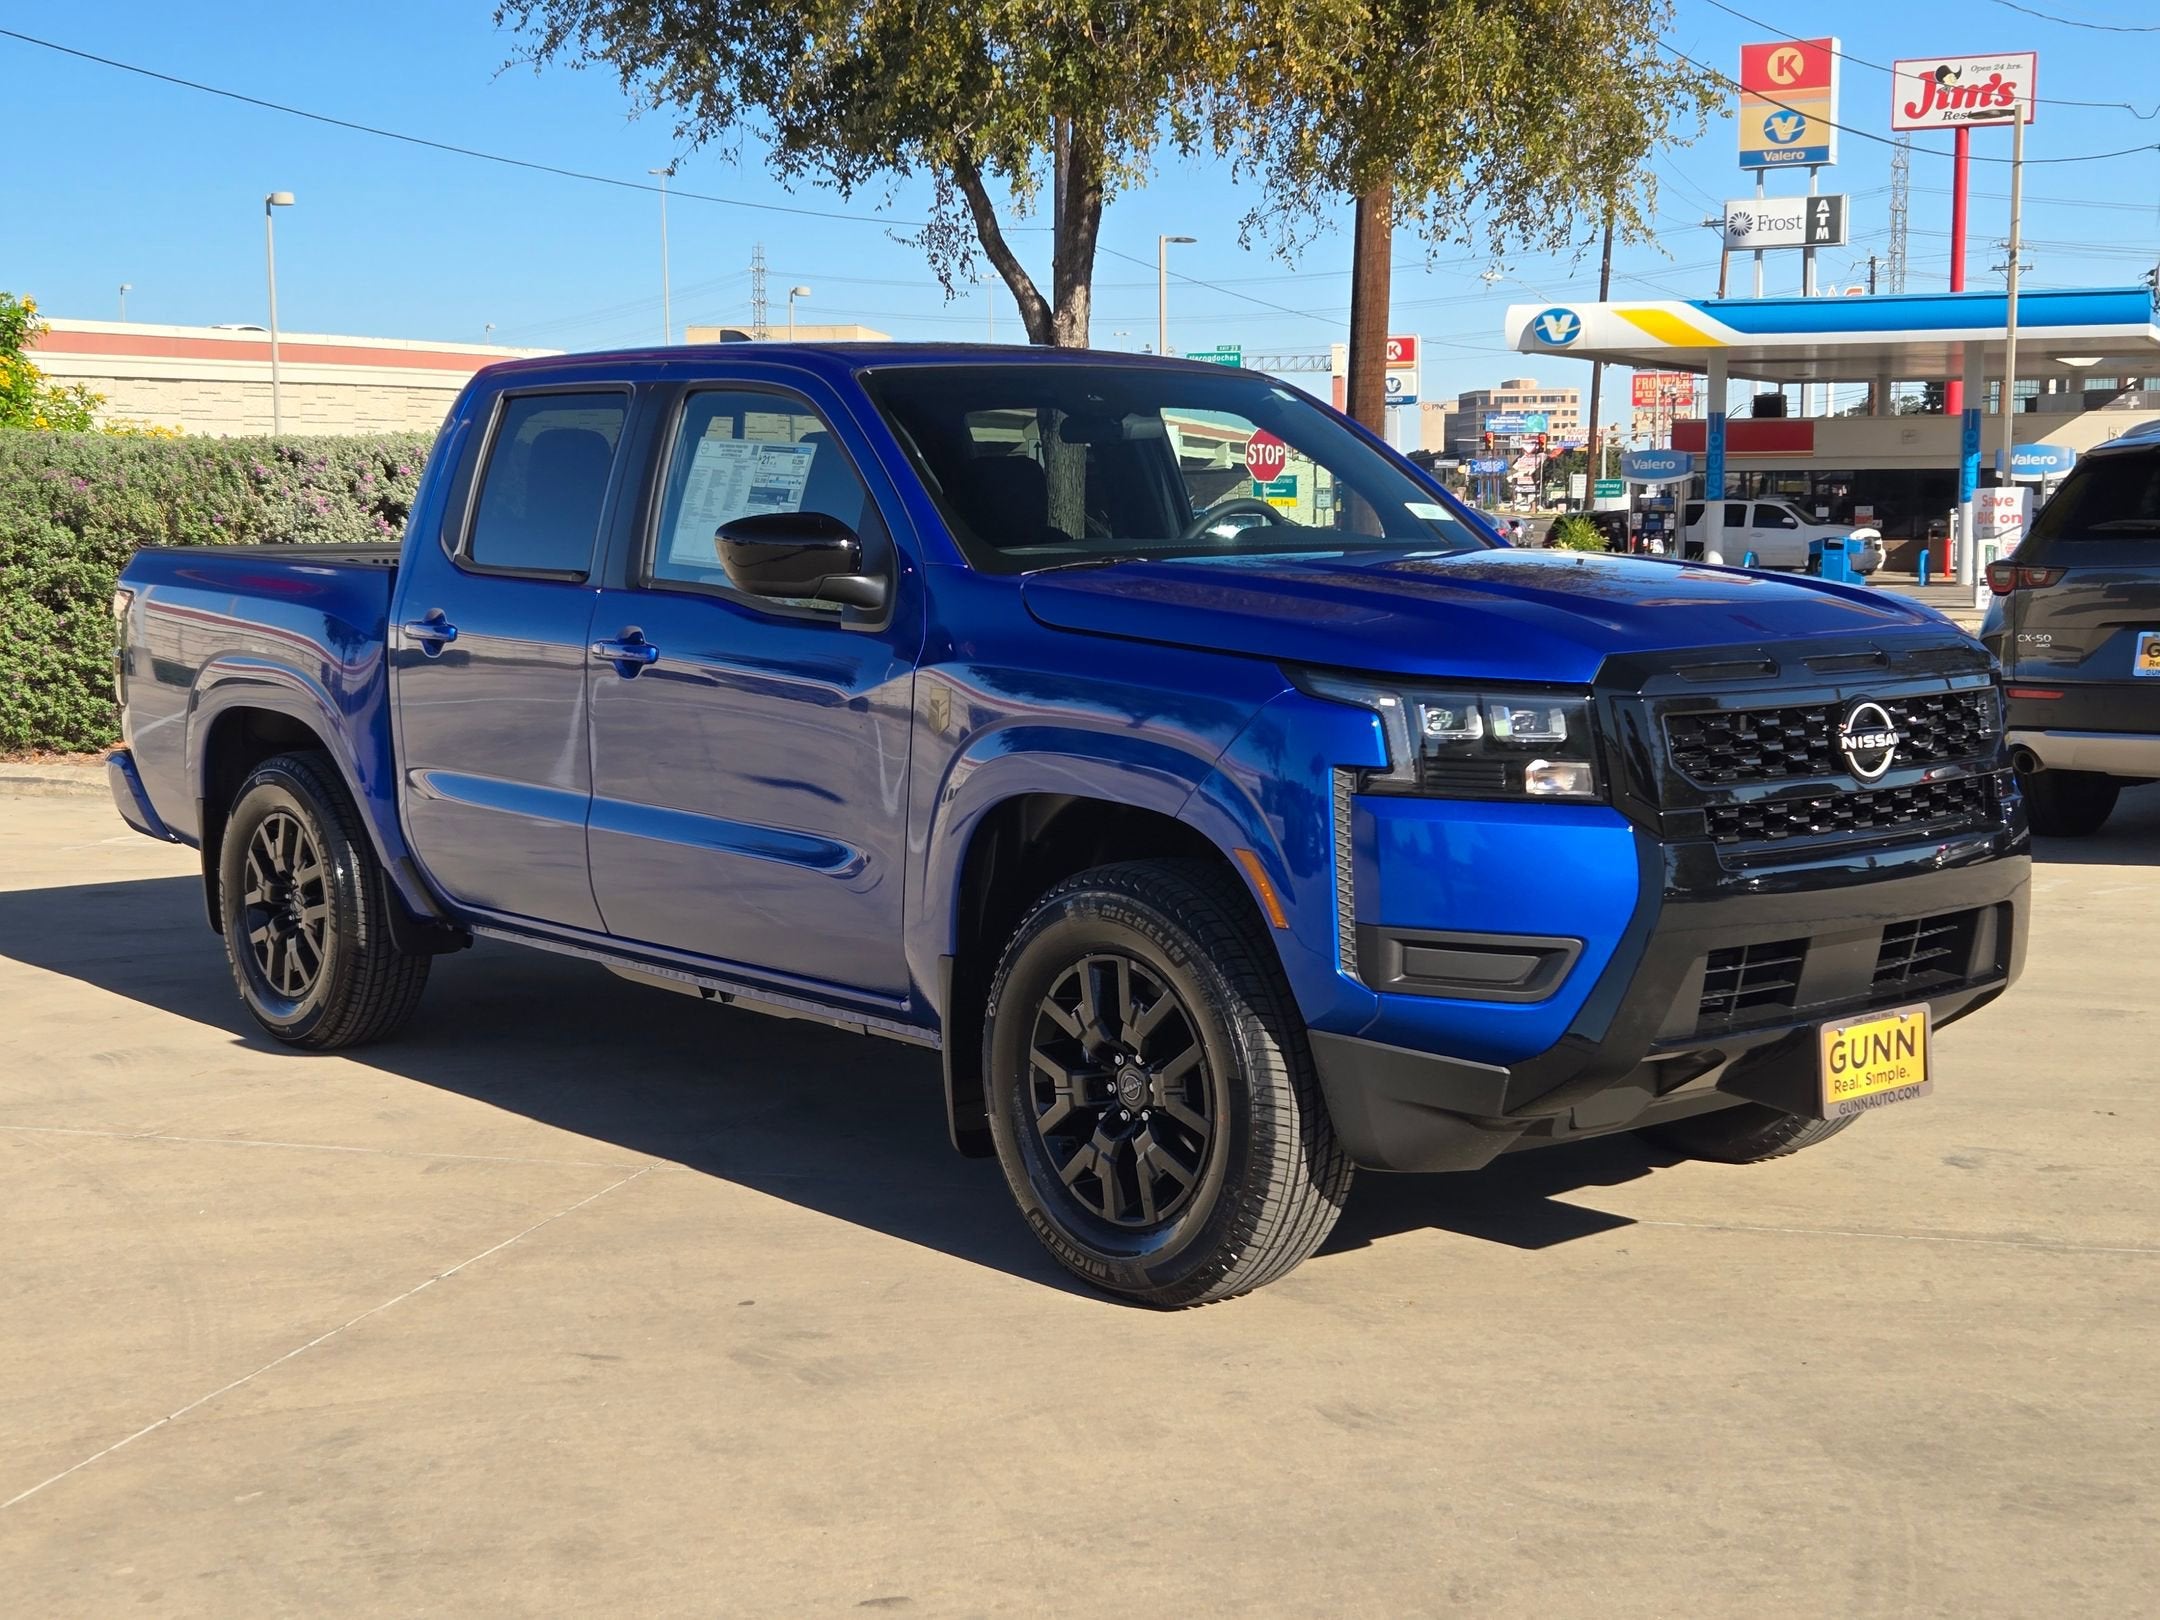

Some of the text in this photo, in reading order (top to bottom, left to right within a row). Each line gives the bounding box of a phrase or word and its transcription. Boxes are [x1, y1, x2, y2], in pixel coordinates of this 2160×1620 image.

[1970, 65, 1992, 73] Open
[1904, 71, 2017, 119] Jim's
[1763, 151, 1805, 162] Valero
[1756, 214, 1803, 232] Frost
[1815, 199, 1830, 240] ATM
[1248, 443, 1284, 465] STOP
[1632, 459, 1676, 470] Valero
[1982, 495, 2014, 508] Save
[1977, 511, 2022, 525] BIG on
[2017, 634, 2052, 643] CX-50
[1841, 732, 1900, 749] NISSAN
[1101, 904, 1185, 962] MICHELIN
[1829, 1026, 1915, 1074] GUNN
[1834, 1066, 1911, 1094] Real. Simple.
[1838, 1085, 1920, 1115] GUNNAUTO.COM
[1031, 1212, 1108, 1277] MICHELIN
